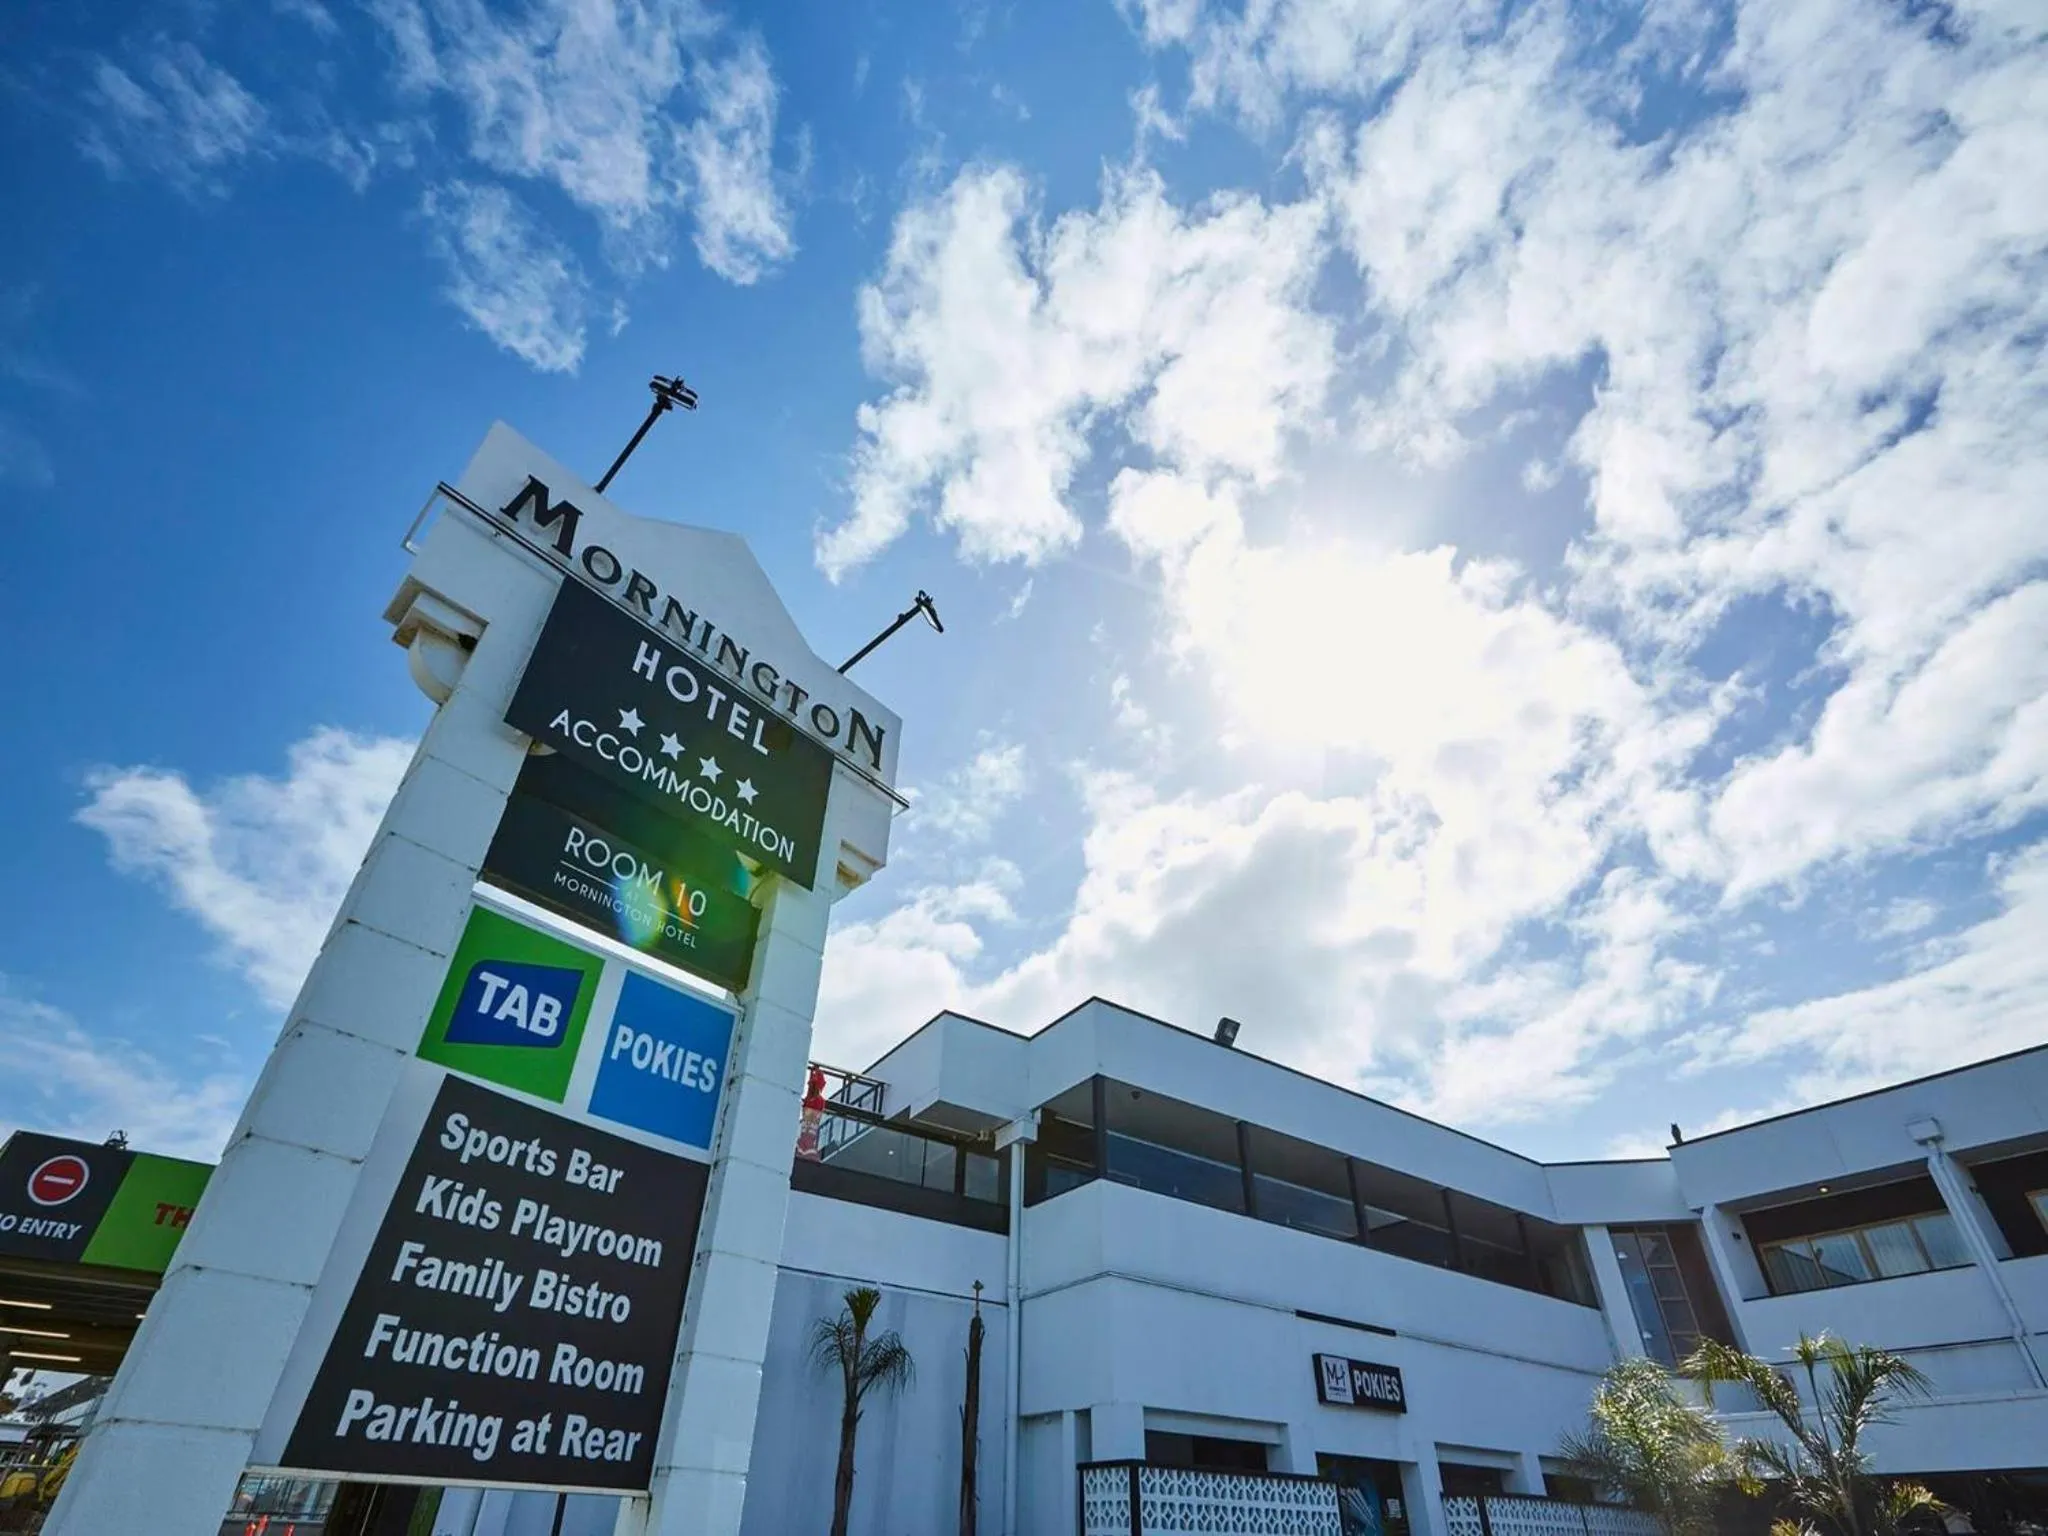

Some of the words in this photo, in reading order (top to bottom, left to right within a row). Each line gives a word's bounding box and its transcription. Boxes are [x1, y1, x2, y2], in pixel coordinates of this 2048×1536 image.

[499, 474, 886, 772] MORNINGTON
[632, 641, 769, 756] HOTEL
[550, 709, 795, 864] ACCOMMODATION
[553, 871, 653, 926] MORNINGTON
[656, 923, 697, 949] HOTEL
[564, 826, 663, 896] ROOM
[676, 883, 706, 916] 10
[477, 971, 562, 1037] TAB
[610, 1024, 718, 1094] POKIES
[440, 1112, 557, 1178] Sports
[565, 1148, 625, 1195] Bar
[18, 1217, 82, 1240] ENTRY
[415, 1174, 503, 1231] Kids
[509, 1198, 663, 1269] Playroom
[390, 1240, 524, 1313] Family
[529, 1269, 632, 1324] Bistro
[363, 1313, 540, 1381] Function
[548, 1342, 645, 1395] Room
[1352, 1369, 1401, 1402] POKIES
[335, 1388, 503, 1461] Parking
[510, 1412, 553, 1455] at
[559, 1414, 642, 1462] Rear
